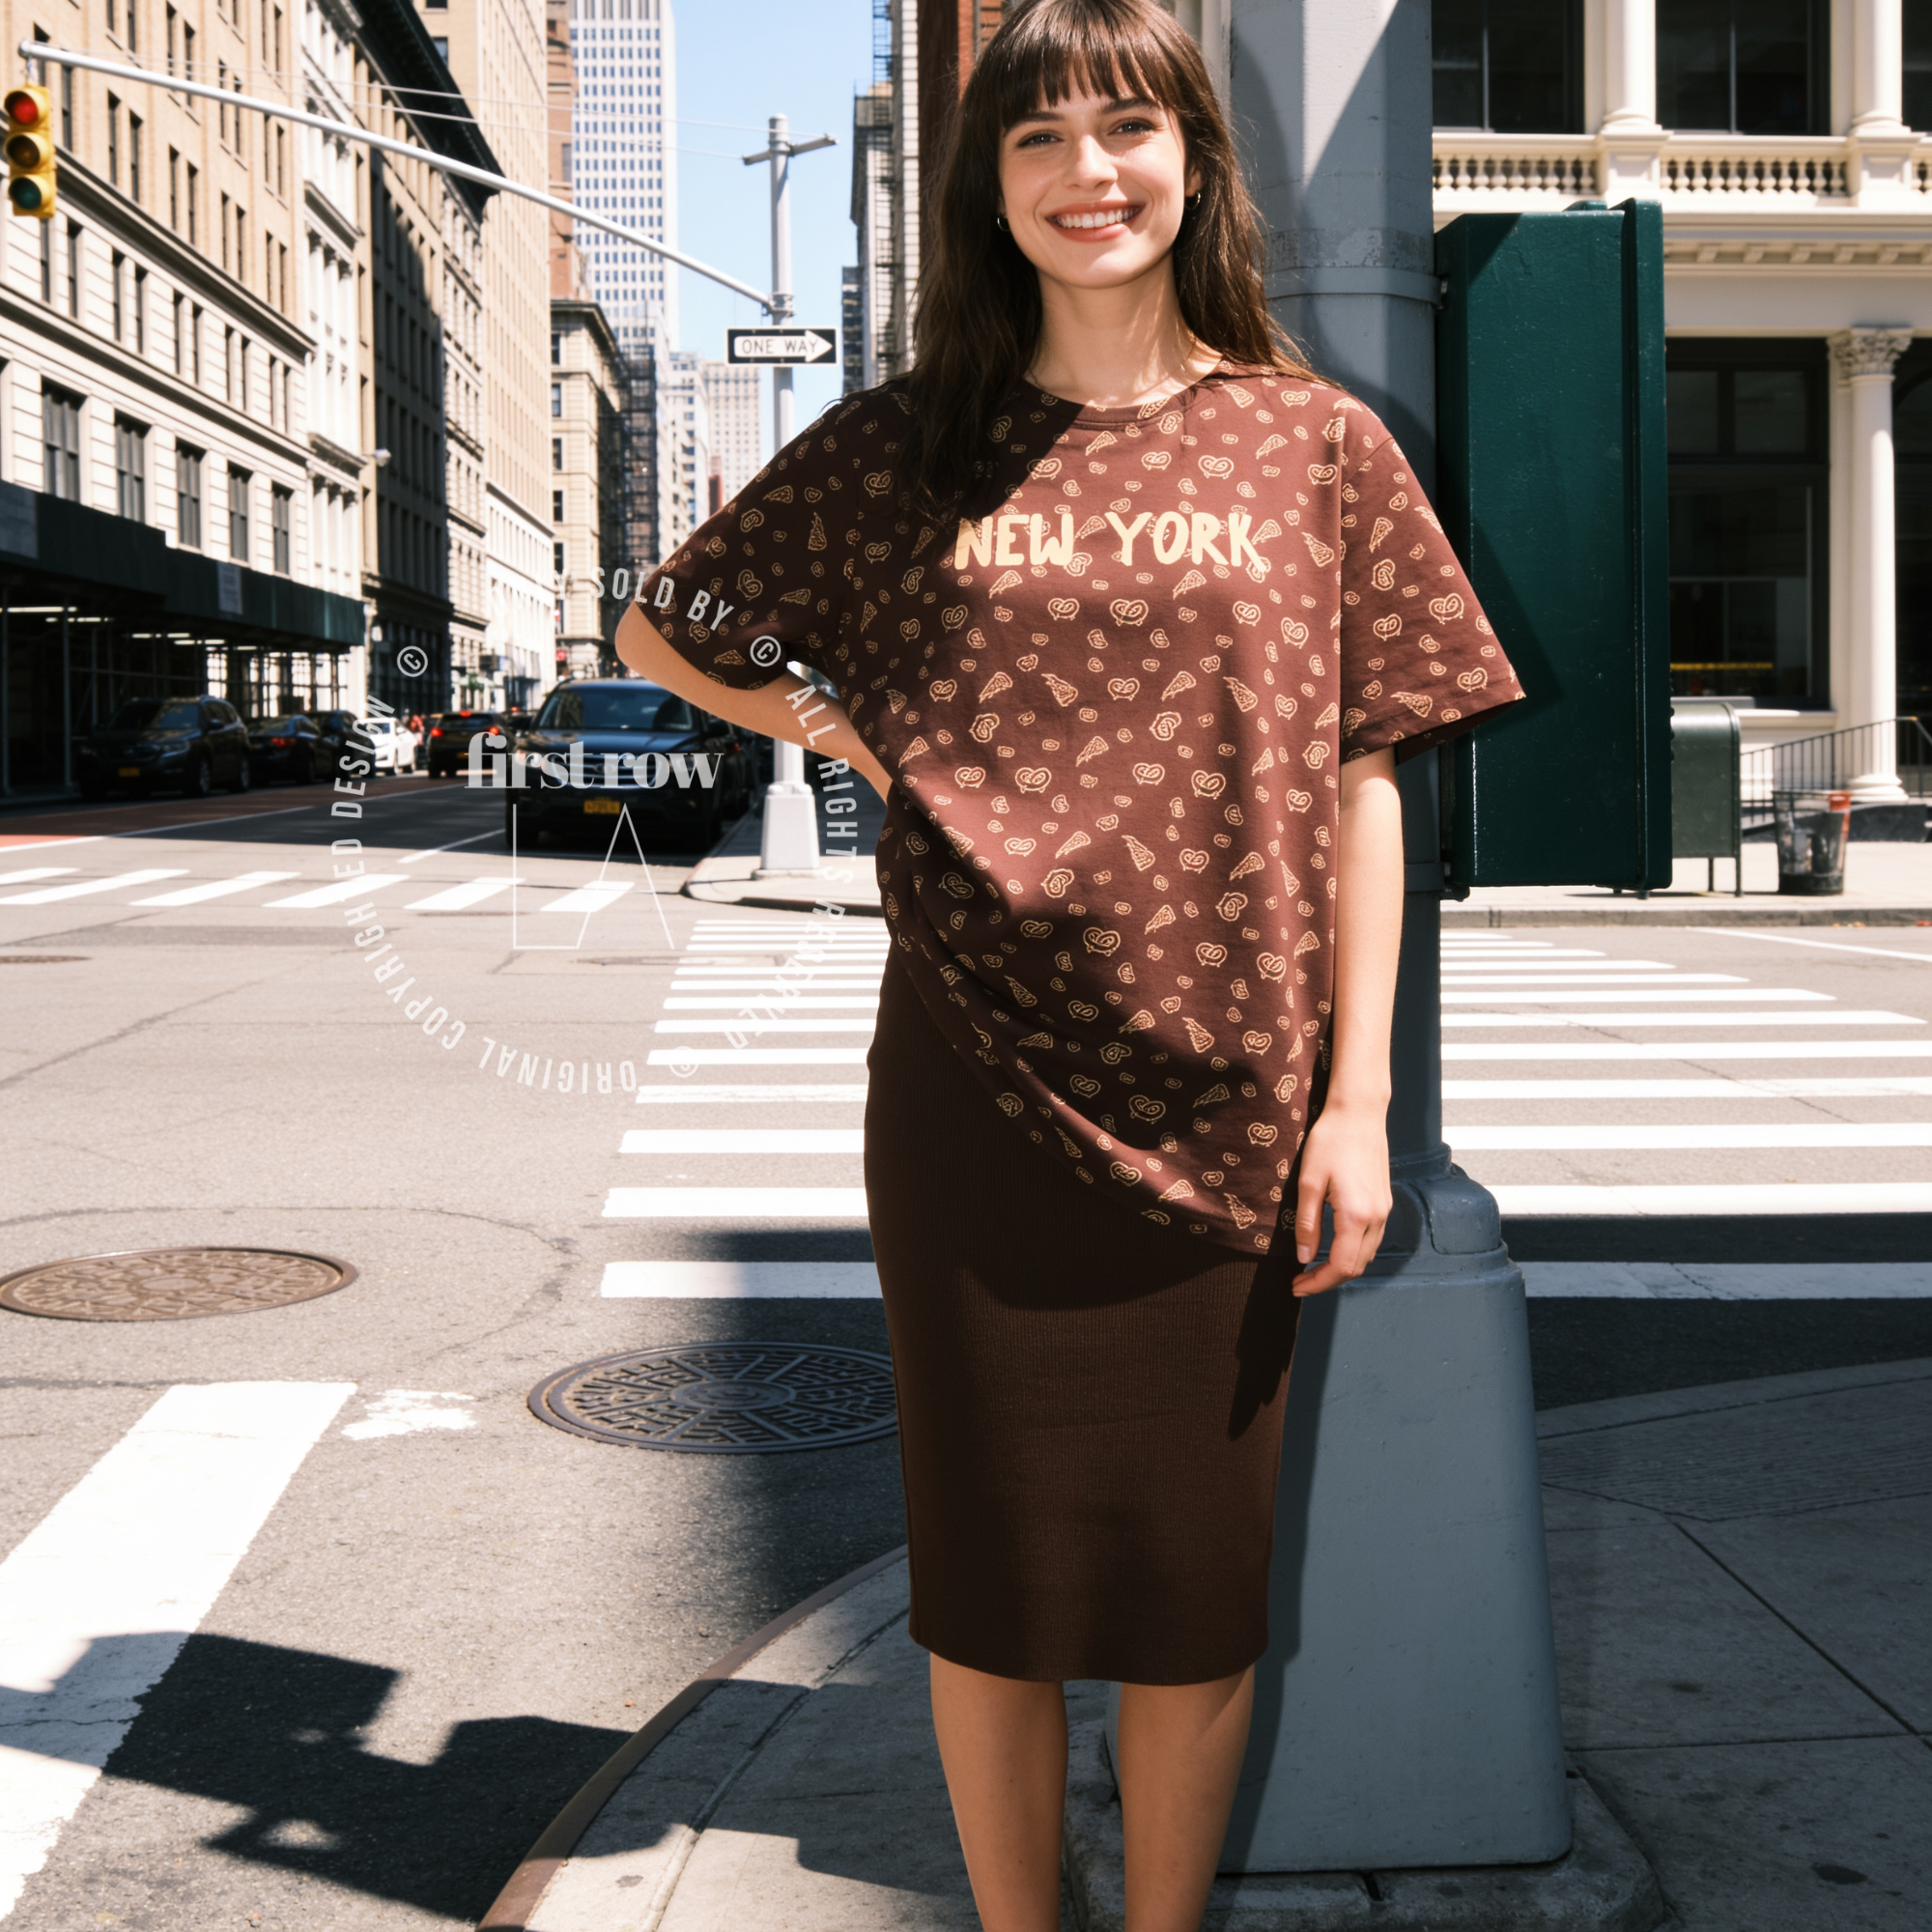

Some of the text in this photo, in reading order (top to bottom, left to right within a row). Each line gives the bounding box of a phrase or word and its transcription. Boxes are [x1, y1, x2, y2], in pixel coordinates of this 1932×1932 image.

[742, 339, 818, 354] ONE WAY
[954, 511, 1266, 572] NEW YORK
